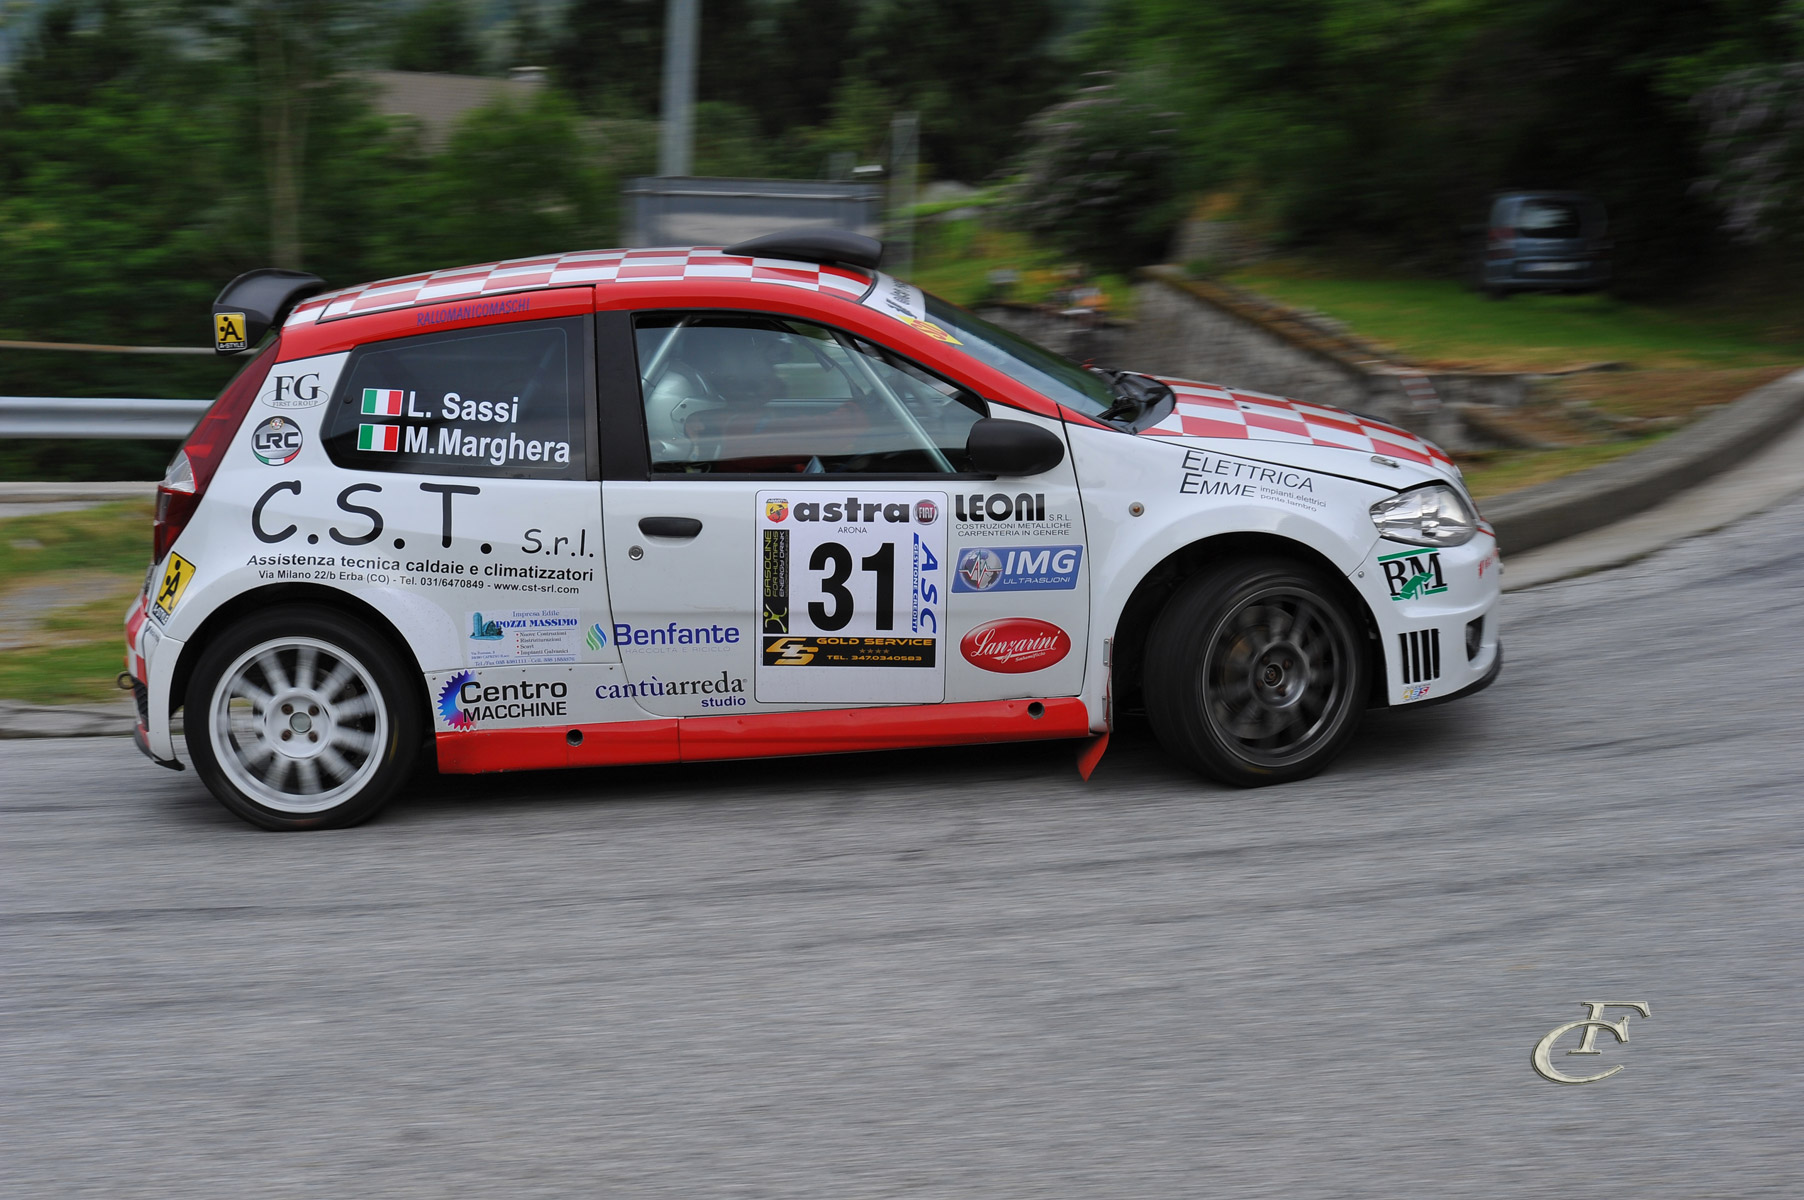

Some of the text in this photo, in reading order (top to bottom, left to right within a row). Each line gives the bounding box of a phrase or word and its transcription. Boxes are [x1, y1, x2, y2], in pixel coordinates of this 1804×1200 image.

[416, 297, 530, 326] RALLOMANICOMASCHI
[272, 372, 321, 401] FG
[408, 391, 519, 423] L. Sassi
[255, 432, 299, 449] LRC
[404, 426, 570, 466] M.Marghera
[1181, 450, 1313, 492] ELETTRICA
[1179, 472, 1257, 498] EMME
[251, 480, 595, 558] C.S.T. S.r.l.
[793, 498, 910, 523] astra
[919, 507, 933, 519] FIAT
[955, 493, 1045, 522] LEONI
[246, 555, 593, 582] Assistenza tecnica caldaie e climatizzatori
[764, 531, 772, 597] GASOLINE
[1005, 549, 1077, 575] IMG
[258, 570, 274, 579] Via
[277, 570, 311, 579] Milano
[314, 570, 336, 580] 22/b
[339, 571, 363, 581] Erba
[366, 573, 390, 585] (CO)
[400, 575, 417, 586] Tel.
[420, 577, 484, 589] 031/6470849
[494, 581, 580, 594] www.cst-srl.com
[808, 542, 894, 631] 31
[920, 541, 938, 634] ASC
[1003, 577, 1071, 585] ULTRASUONI
[495, 618, 578, 628] POZZI MASSIMO
[613, 623, 740, 646] Benfante
[864, 638, 933, 646] SERVICE
[970, 628, 1061, 664] Lanzarini
[460, 681, 567, 704] Centro
[701, 696, 746, 708] studio
[463, 701, 567, 723] MACCHINE
